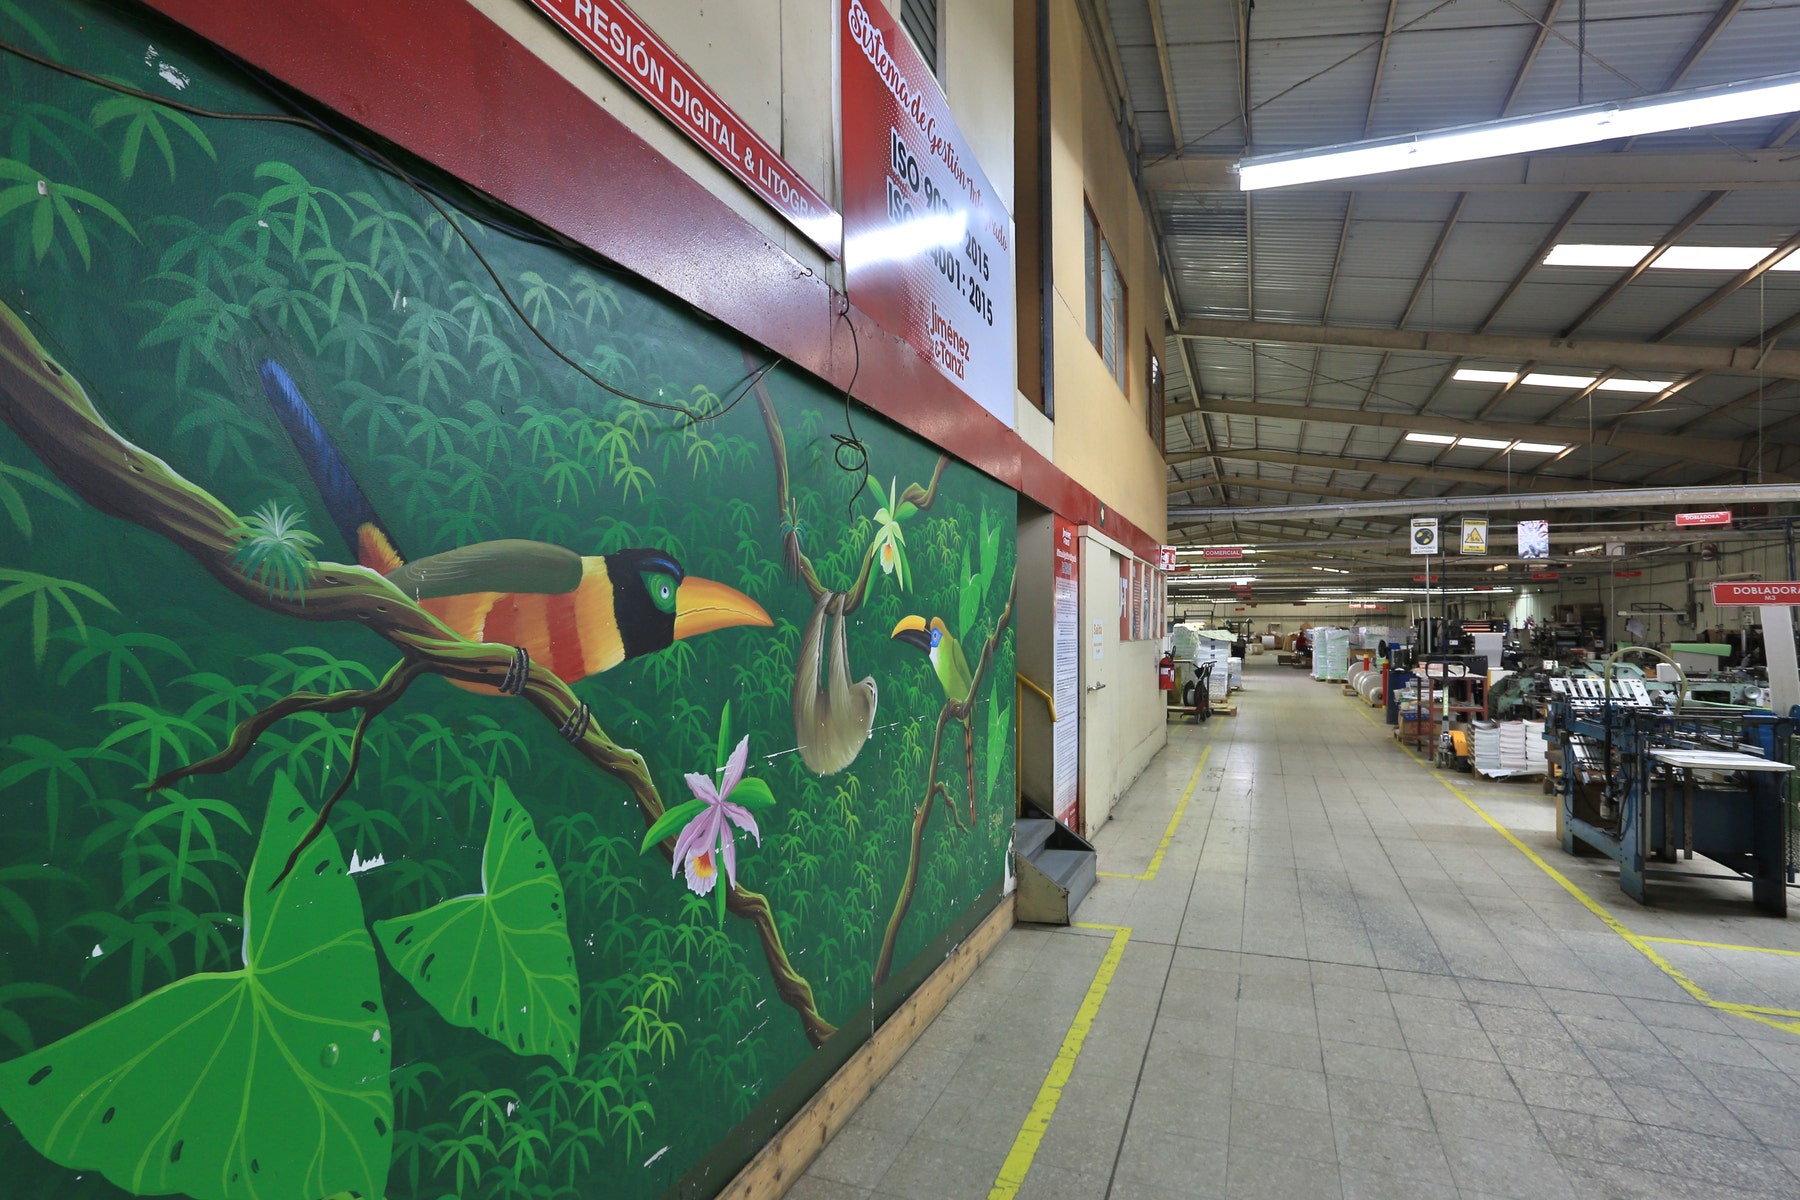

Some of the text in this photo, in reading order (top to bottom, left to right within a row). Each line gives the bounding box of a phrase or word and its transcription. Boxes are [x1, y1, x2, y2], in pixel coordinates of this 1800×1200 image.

[558, 0, 664, 93] RESIÓN
[670, 76, 741, 161] DIGITAL
[744, 146, 755, 174] &
[850, 3, 910, 108] Sistema
[911, 94, 927, 132] de
[892, 131, 920, 194] ISO
[965, 229, 989, 282] 2015
[930, 302, 970, 362] Jiménez
[969, 276, 993, 327] 2015
